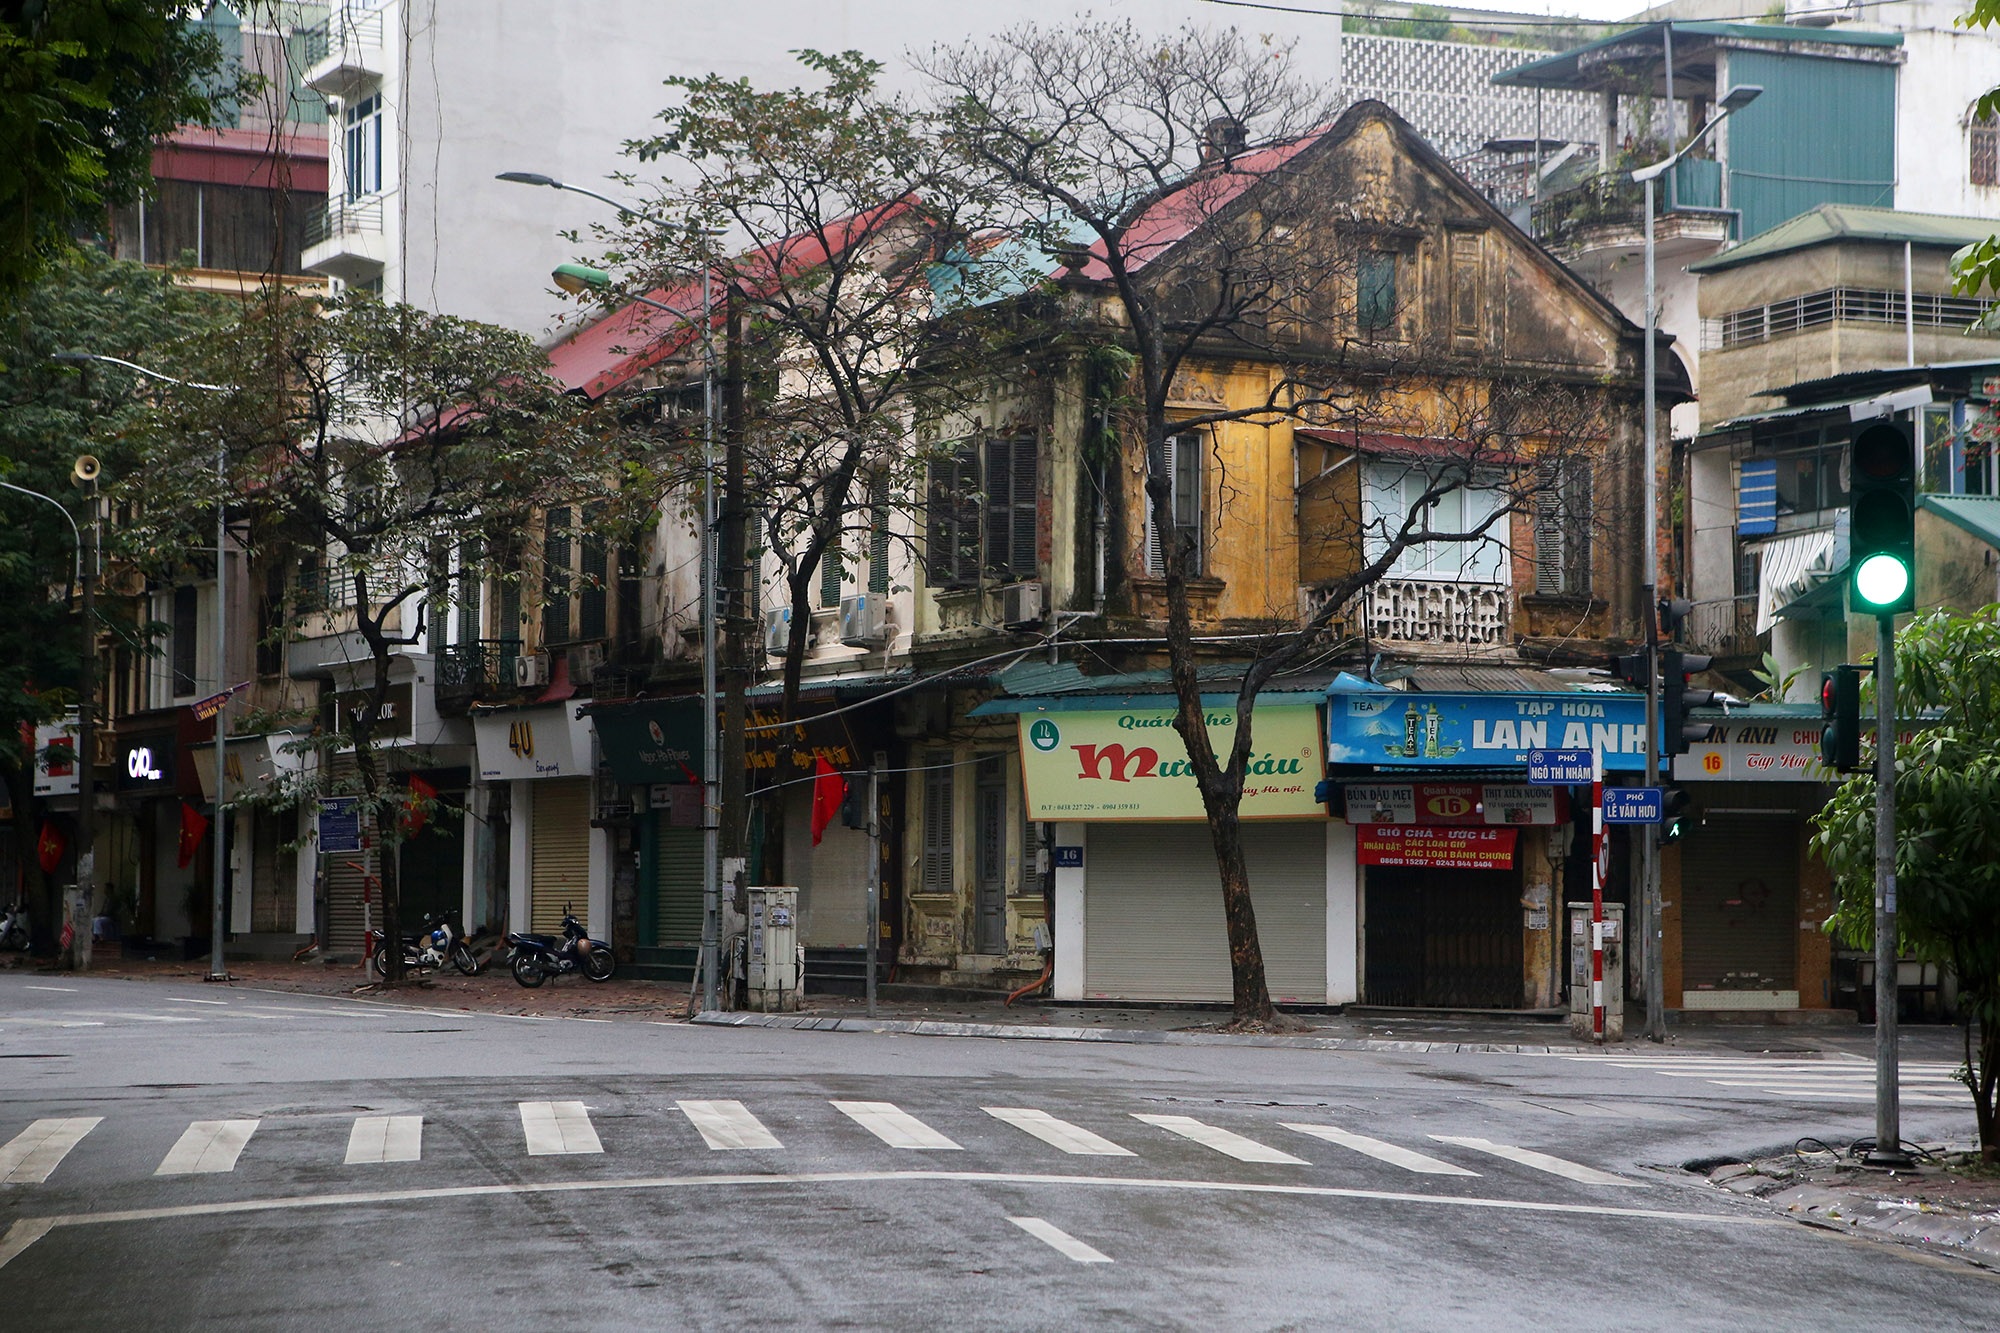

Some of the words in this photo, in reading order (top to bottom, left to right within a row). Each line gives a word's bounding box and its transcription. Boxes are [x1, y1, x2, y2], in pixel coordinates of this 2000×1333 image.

[1516, 701, 1554, 718] TẠP
[1562, 702, 1604, 718] HÓA
[509, 720, 534, 759] 4U
[1473, 719, 1547, 750] LAN
[1562, 721, 1647, 754] ANH
[1736, 726, 1778, 745] ANH
[1558, 752, 1578, 763] PHỐ
[1704, 756, 1721, 771] 16
[1532, 764, 1549, 780] NGÔ
[1551, 764, 1563, 780] THÌ
[1566, 764, 1592, 782] NHẬM
[1626, 791, 1644, 801] PHỐ
[1436, 798, 1461, 814] 16
[1607, 803, 1618, 819] LÊ
[1619, 803, 1637, 819] VĂN
[1404, 838, 1424, 847] CÁC
[1063, 849, 1077, 860] 16
[1404, 848, 1423, 857] CÁC
